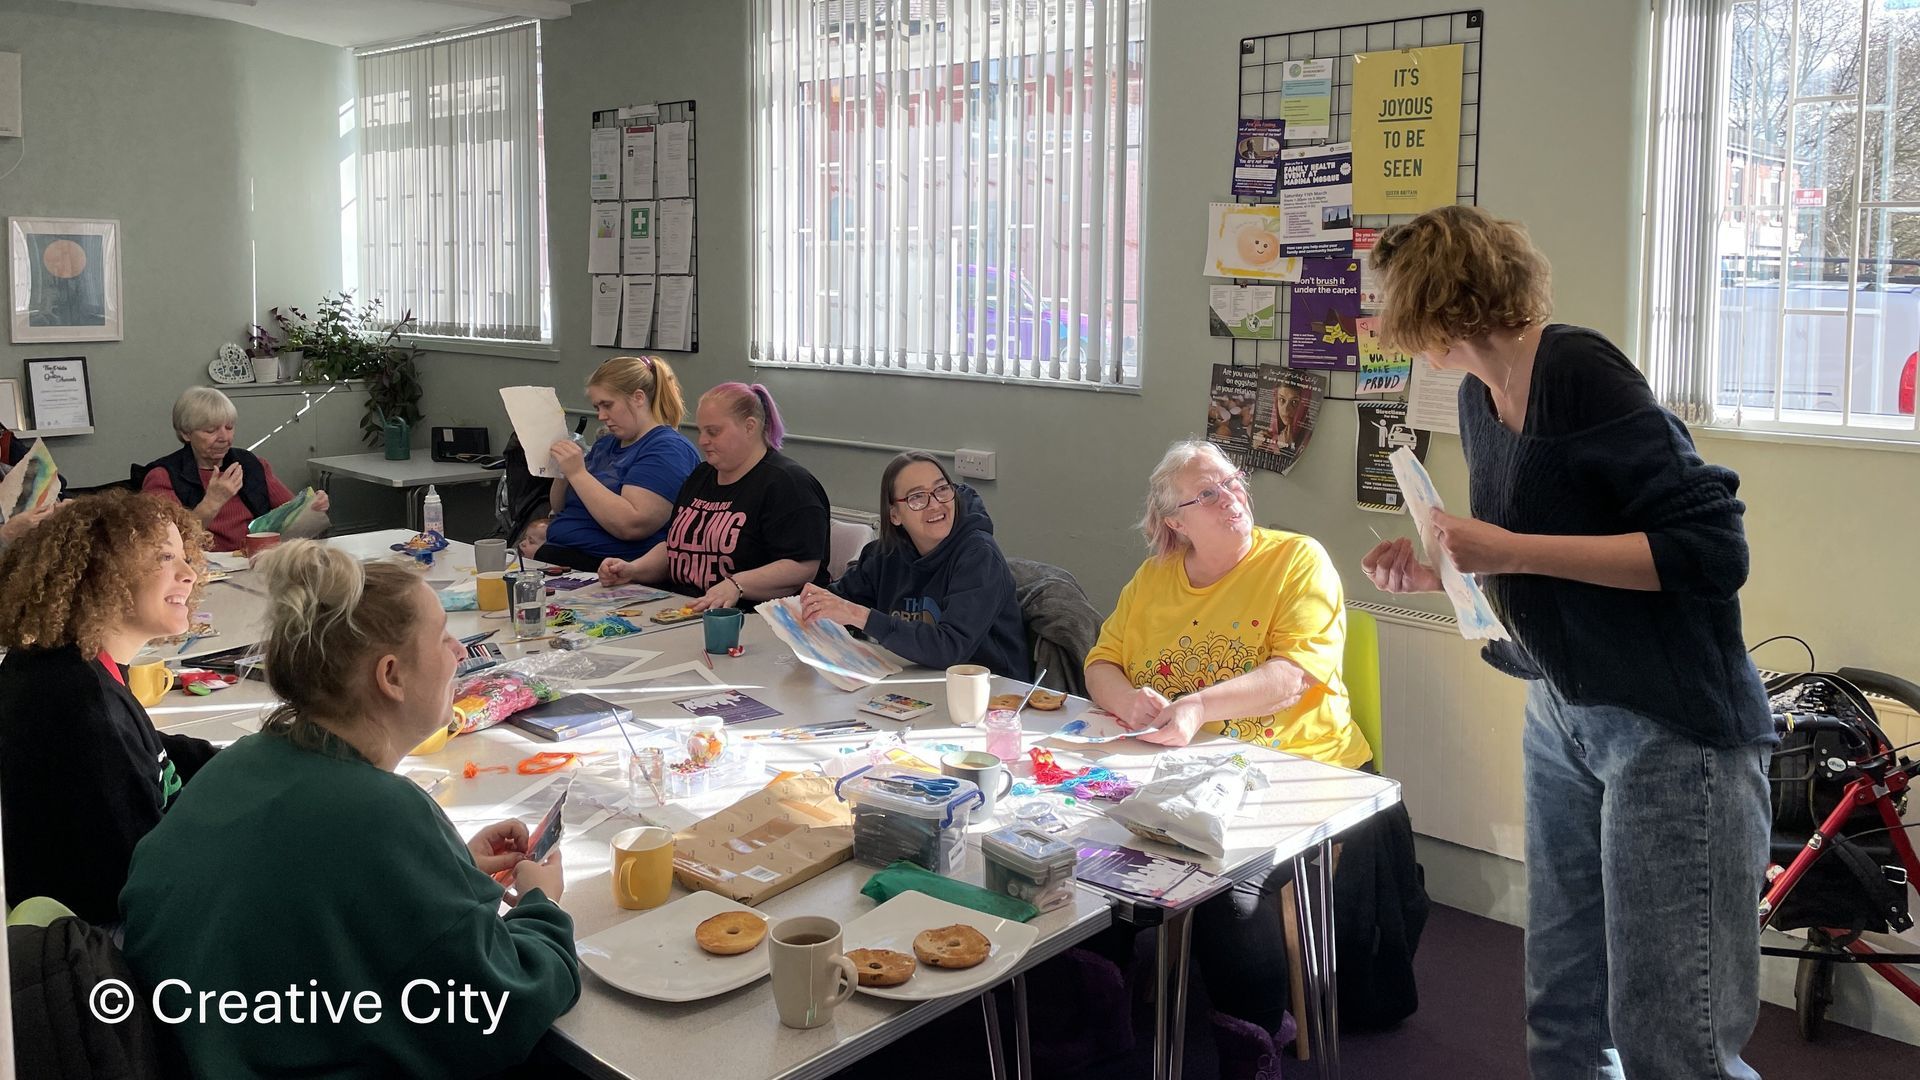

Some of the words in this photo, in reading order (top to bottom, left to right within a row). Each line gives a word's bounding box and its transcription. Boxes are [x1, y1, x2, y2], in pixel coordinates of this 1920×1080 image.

[1394, 68, 1420, 87] IT'S
[1378, 97, 1433, 117] JOYOUS
[1384, 131, 1401, 148] TO
[1406, 129, 1426, 148] BE
[1284, 164, 1309, 174] FAMILY
[1311, 161, 1336, 170] HEALTH
[1384, 159, 1423, 177] SEEN
[1284, 171, 1307, 180] EVENT
[1308, 170, 1318, 178] AT
[1313, 174, 1340, 183] MOSQUE
[1316, 277, 1338, 285] brush
[1339, 277, 1345, 285] it
[1294, 286, 1317, 294] under
[1318, 286, 1331, 294] the
[1332, 286, 1357, 295] carpet
[1223, 367, 1232, 375] Are
[1232, 369, 1243, 378] you
[1244, 370, 1258, 379] walki
[1363, 375, 1400, 391] PROUD
[1375, 408, 1406, 416] Directions
[667, 506, 747, 554] OLLING
[667, 550, 735, 589] TONES
[904, 597, 923, 612] TH
[891, 610, 922, 622] ORT
